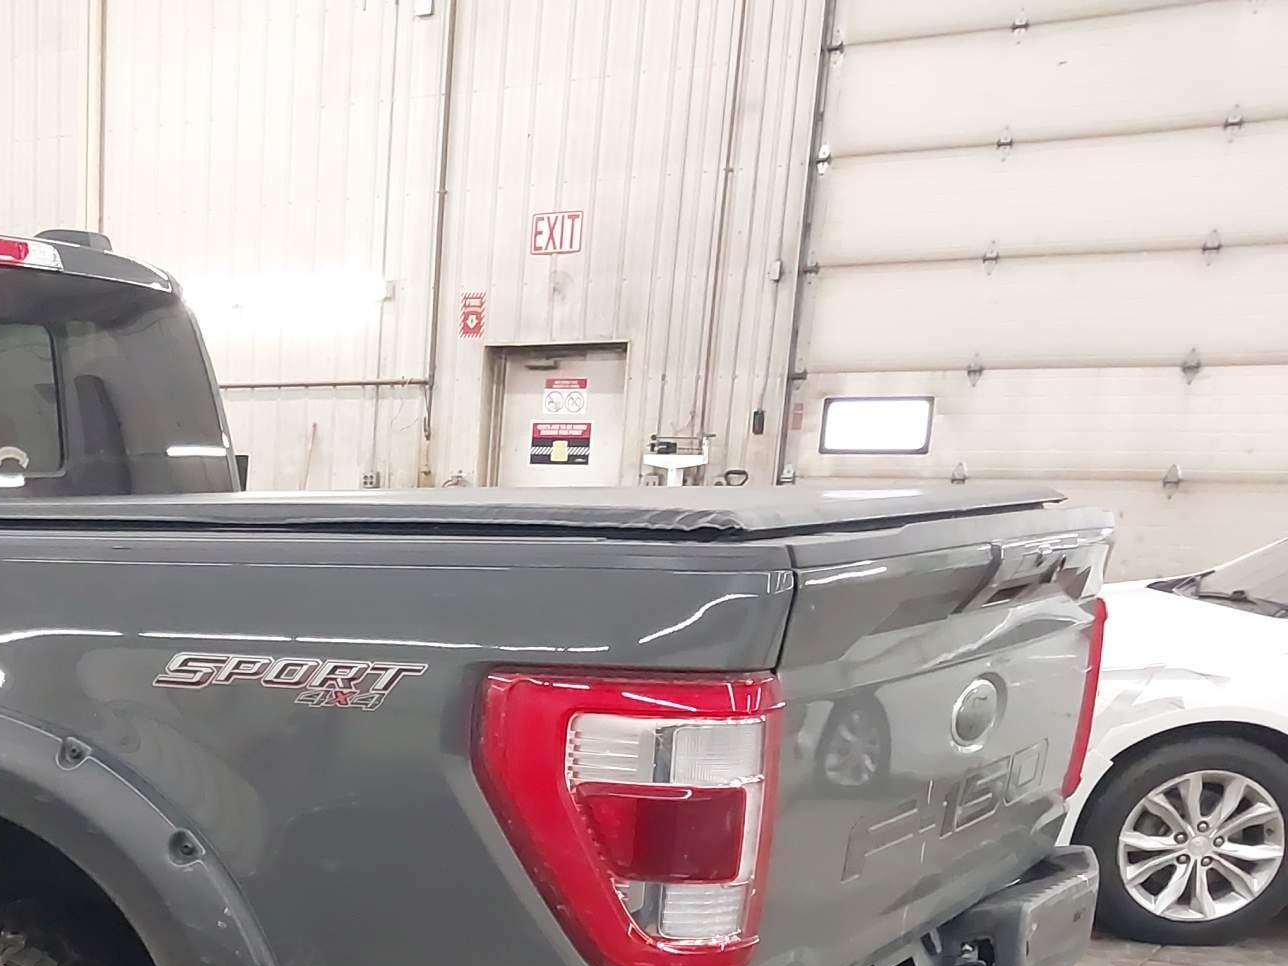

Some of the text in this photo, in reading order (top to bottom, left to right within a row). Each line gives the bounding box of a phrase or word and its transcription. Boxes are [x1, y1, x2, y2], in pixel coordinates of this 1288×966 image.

[533, 214, 580, 251] EXIT
[153, 652, 429, 692] SPORT
[840, 738, 1049, 883] F-150
